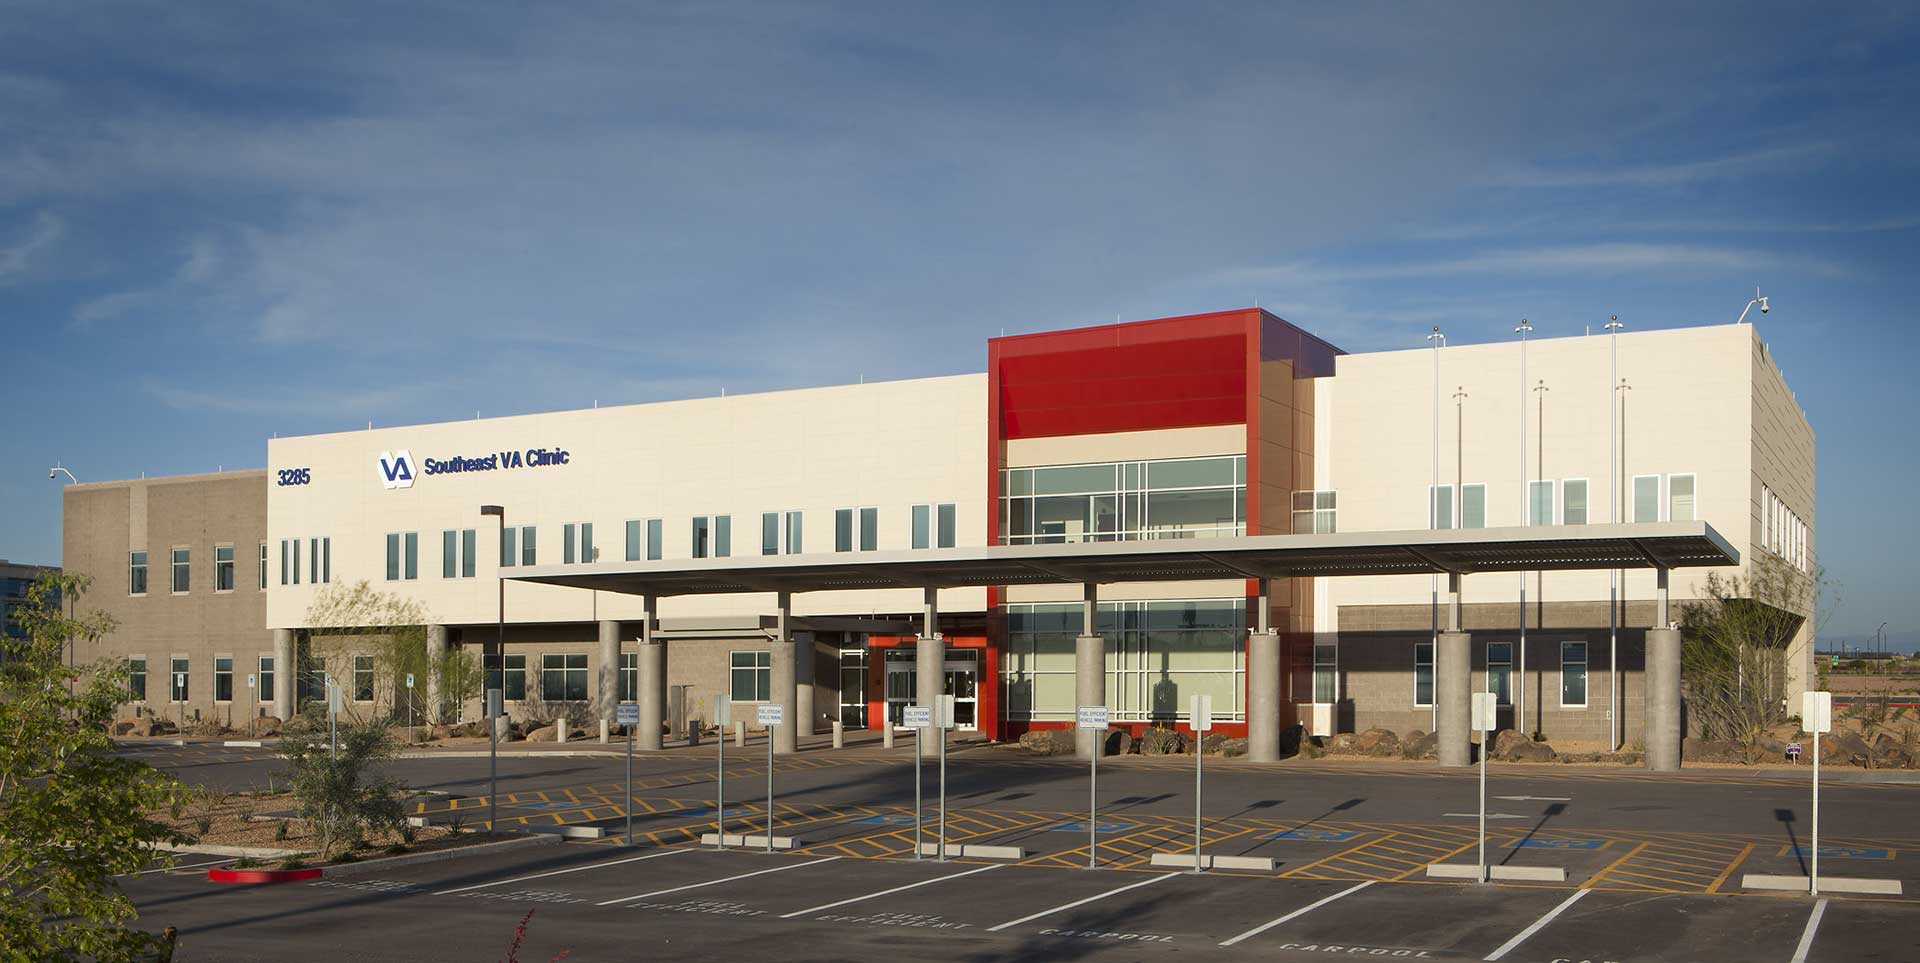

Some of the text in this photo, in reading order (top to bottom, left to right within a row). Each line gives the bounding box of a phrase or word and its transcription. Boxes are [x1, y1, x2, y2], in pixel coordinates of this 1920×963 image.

[380, 457, 413, 481] VA
[424, 447, 570, 476] Southeast VA Clinic
[277, 468, 311, 487] 3285
[624, 902, 768, 916] EFFICIENT
[871, 912, 943, 922] FUEL
[815, 914, 975, 930] EFFICIENT
[1039, 928, 1174, 943] CARPOOL
[1279, 943, 1432, 959] CARPOOL
